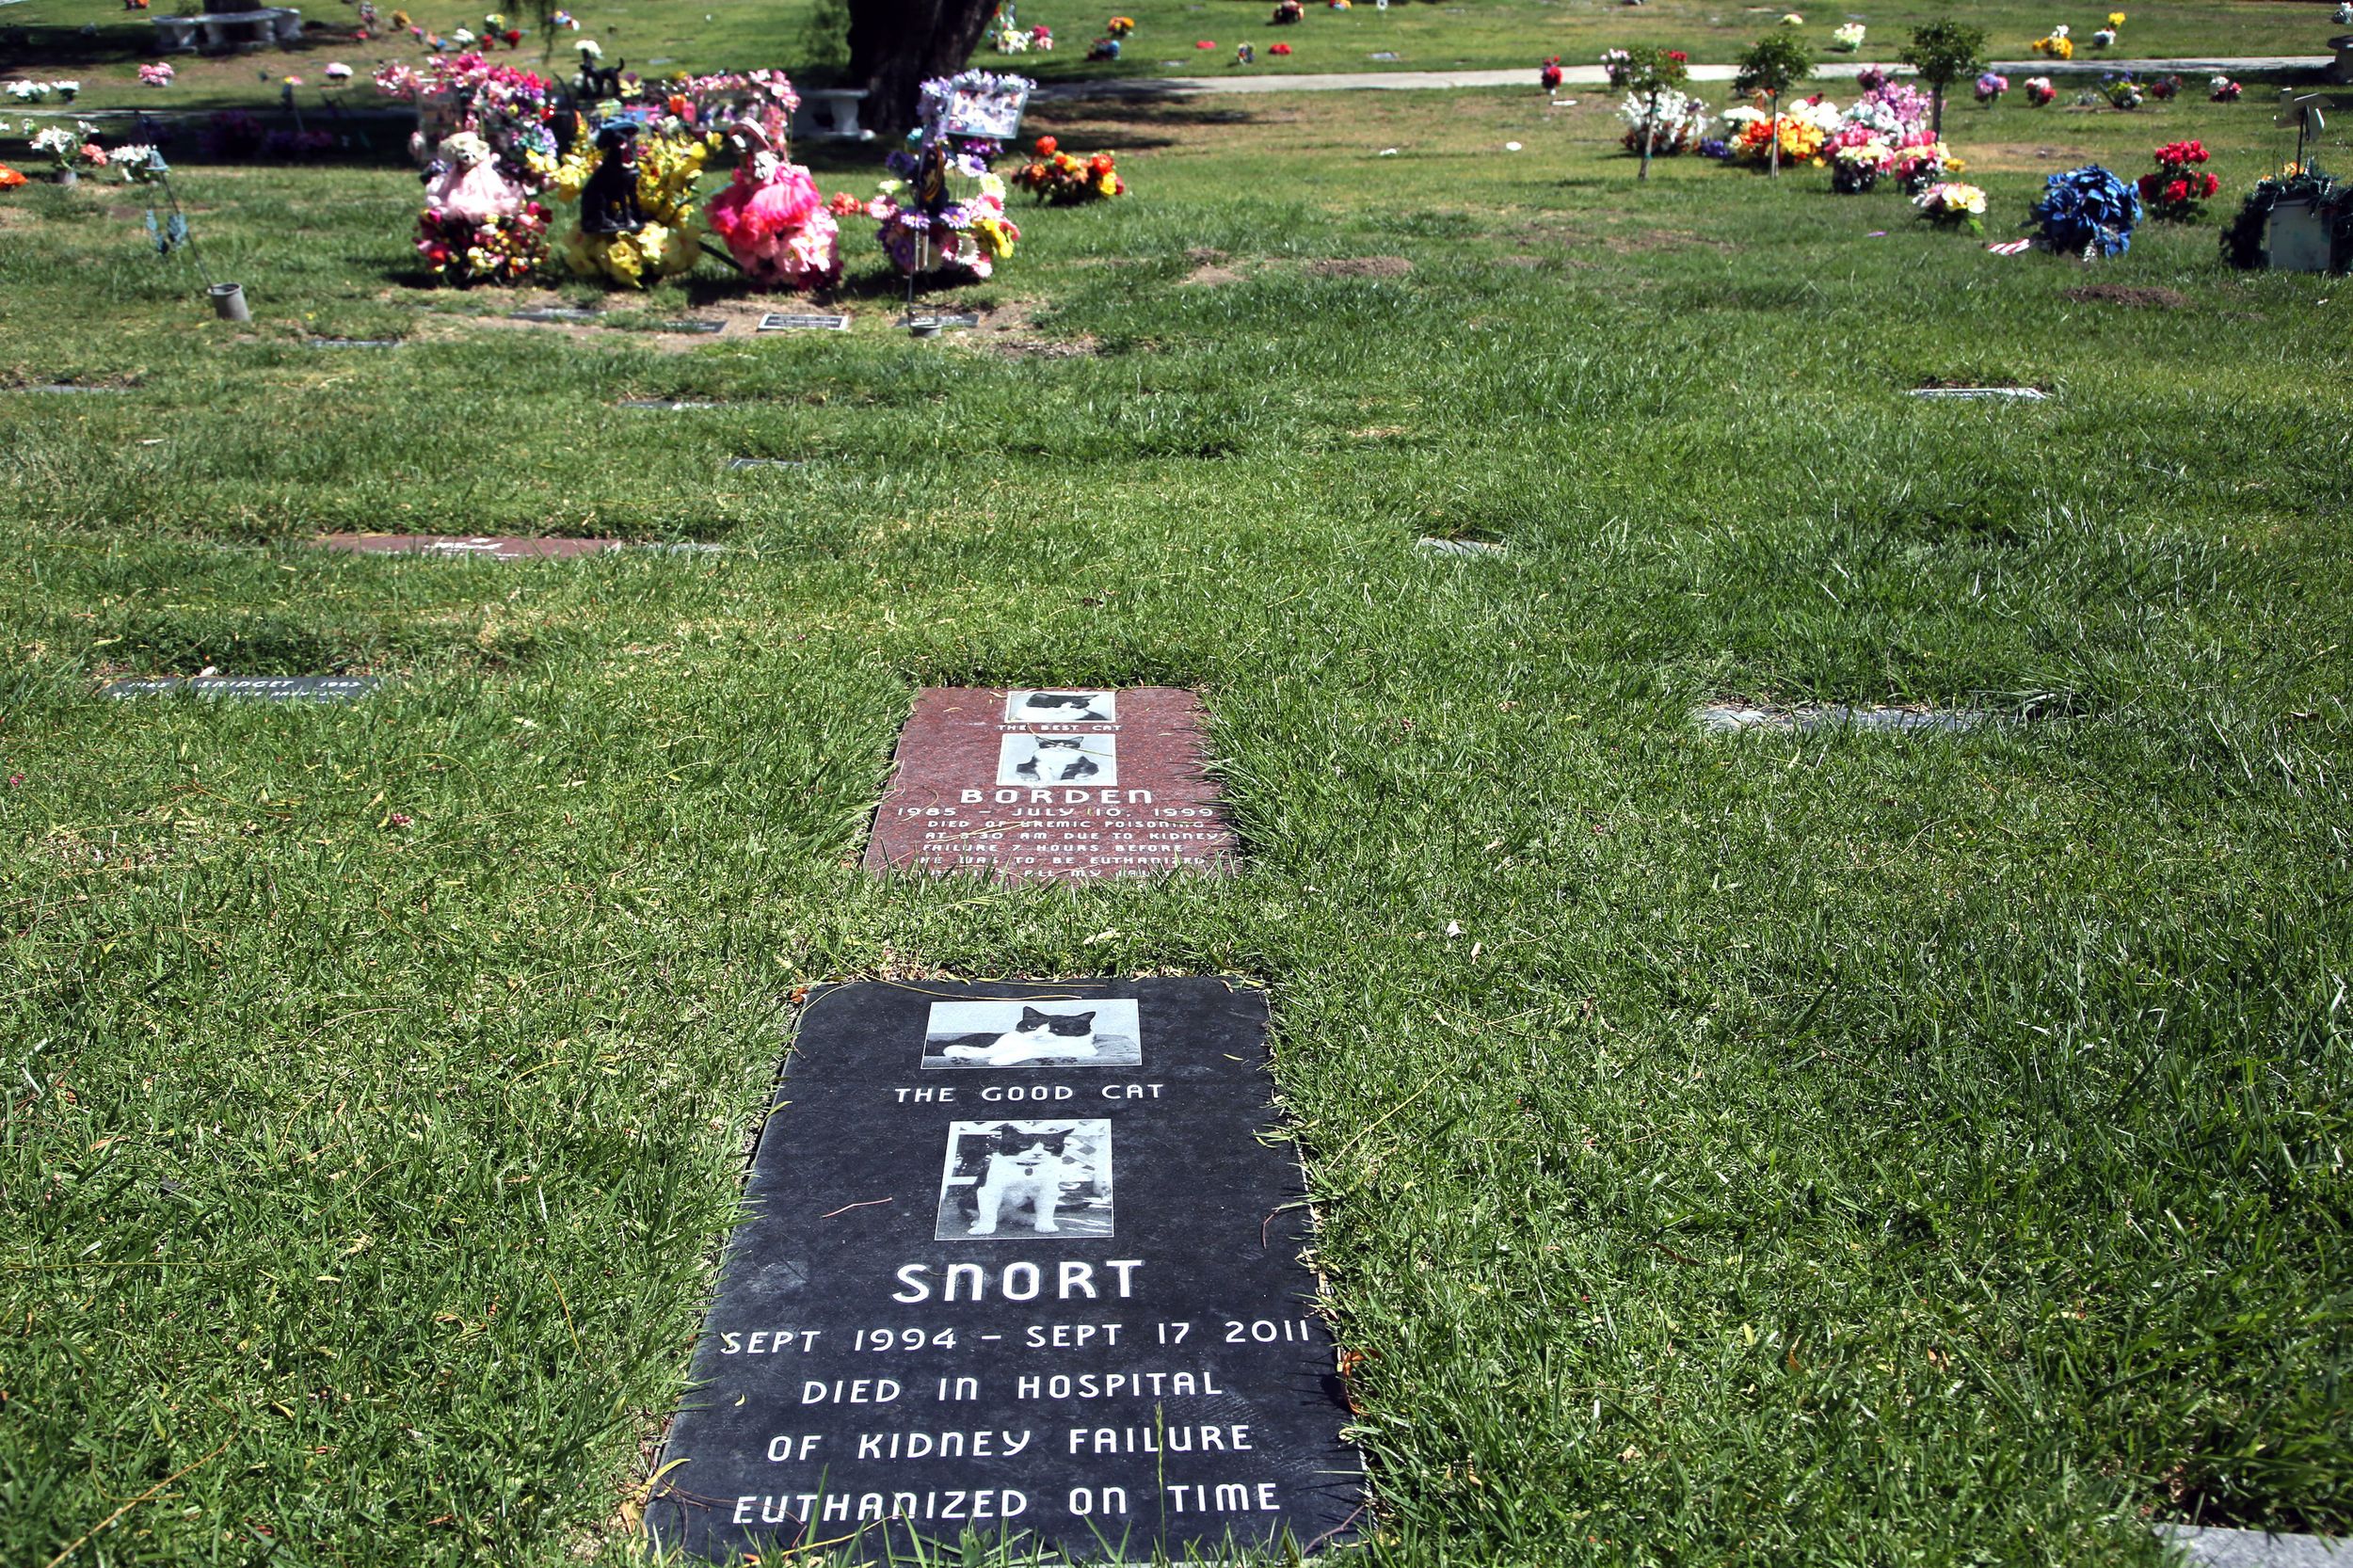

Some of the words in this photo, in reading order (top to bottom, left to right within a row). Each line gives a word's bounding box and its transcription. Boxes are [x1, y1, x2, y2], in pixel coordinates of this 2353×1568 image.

[960, 789, 1152, 805] BORDEN
[897, 807, 957, 817] 1985
[1011, 808, 1075, 817] JULY
[1153, 808, 1214, 817] 1999
[927, 820, 970, 828] DIED
[984, 820, 1007, 828] OF
[1019, 820, 1092, 828] UREMIC
[1104, 820, 1205, 828] POISONING
[925, 831, 947, 840] AT
[920, 856, 943, 864] HE
[958, 856, 1000, 864] WAS
[1015, 856, 1036, 864] TO
[1052, 856, 1076, 864] BE
[1089, 856, 1206, 864] EUTHANIZED
[1070, 869, 1102, 877] MY
[894, 1087, 954, 1103] THE
[981, 1085, 1074, 1101] GOOD
[1101, 1083, 1163, 1099] CAT
[891, 1259, 1143, 1304] SNORT
[720, 1330, 822, 1354] SEPT
[854, 1327, 957, 1352] 1994
[1026, 1323, 1123, 1348] SEPT
[1158, 1322, 1190, 1345] 17
[1225, 1320, 1309, 1343] 2011
[801, 1379, 901, 1404] DIED
[938, 1377, 978, 1401] IN
[1017, 1371, 1223, 1400] HOSPITAL
[767, 1434, 822, 1463] OF
[857, 1430, 1031, 1460] KIDNEY
[1069, 1424, 1253, 1454] FAILURE
[732, 1489, 1028, 1525] EUTHANIZED
[1068, 1486, 1127, 1516] ON
[1166, 1482, 1281, 1512] TIME
